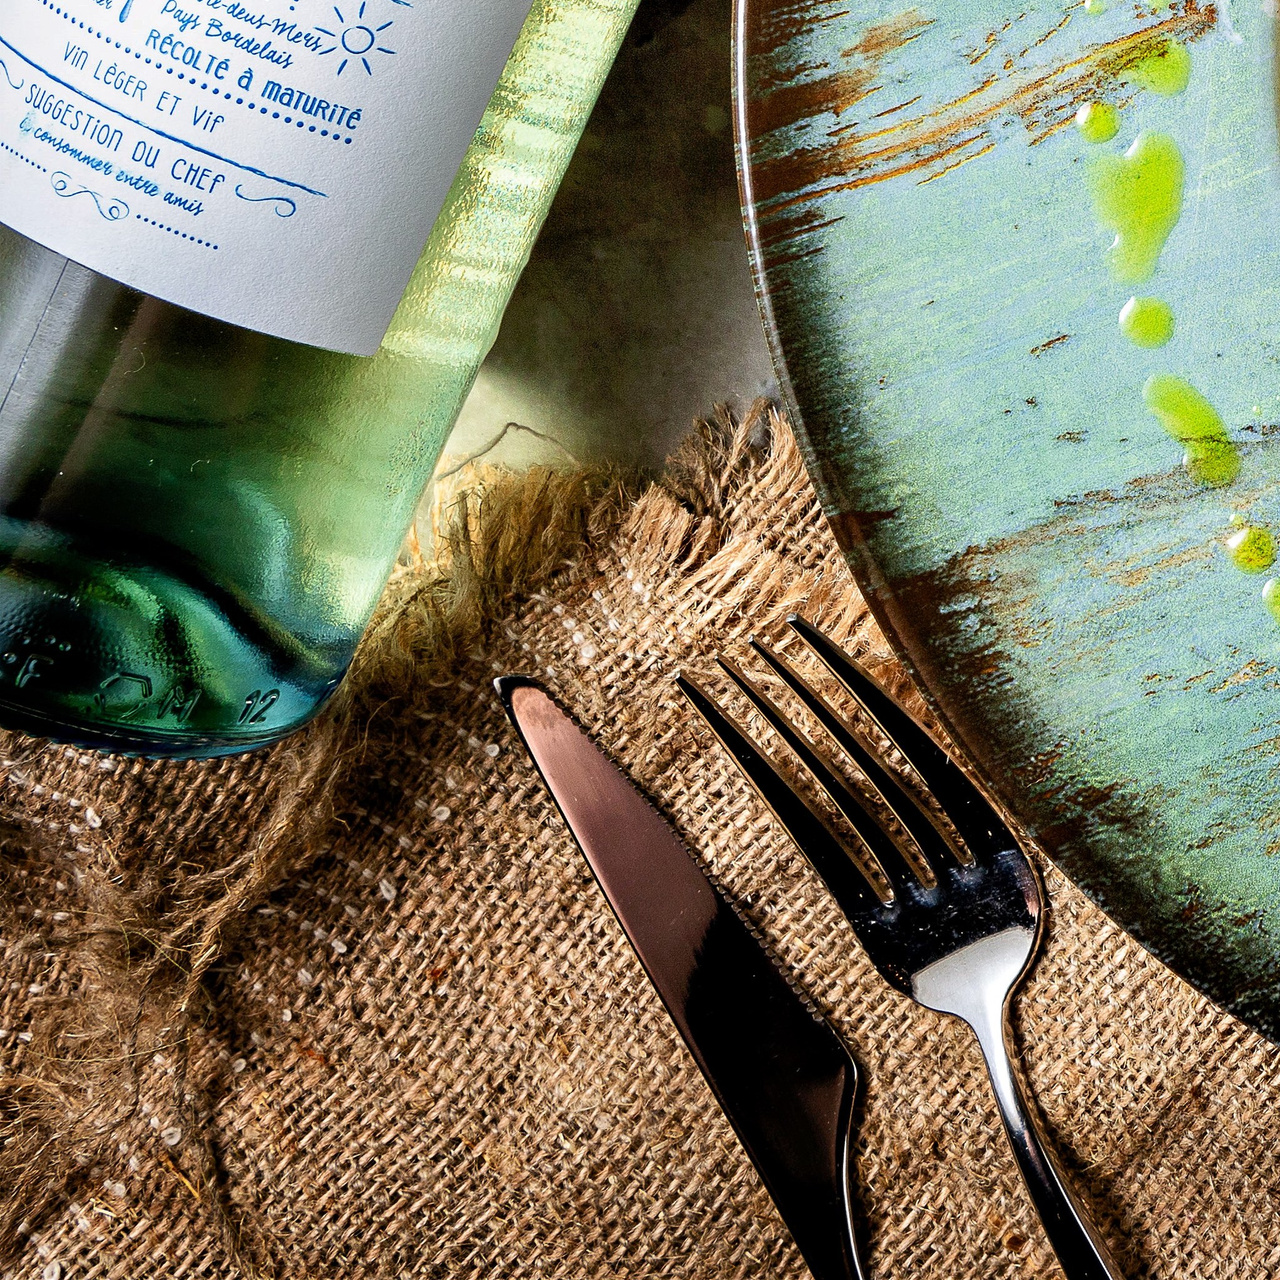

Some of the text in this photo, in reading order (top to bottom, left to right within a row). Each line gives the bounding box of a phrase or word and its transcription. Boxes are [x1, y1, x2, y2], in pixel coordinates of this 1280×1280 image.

[205, 18, 294, 69] Bordelais
[25, 83, 124, 152] SUGGESTION
[131, 140, 161, 169] DU
[156, 91, 183, 116] ET
[33, 126, 113, 176] consommer
[115, 169, 159, 197] entre
[163, 189, 204, 216] amis
